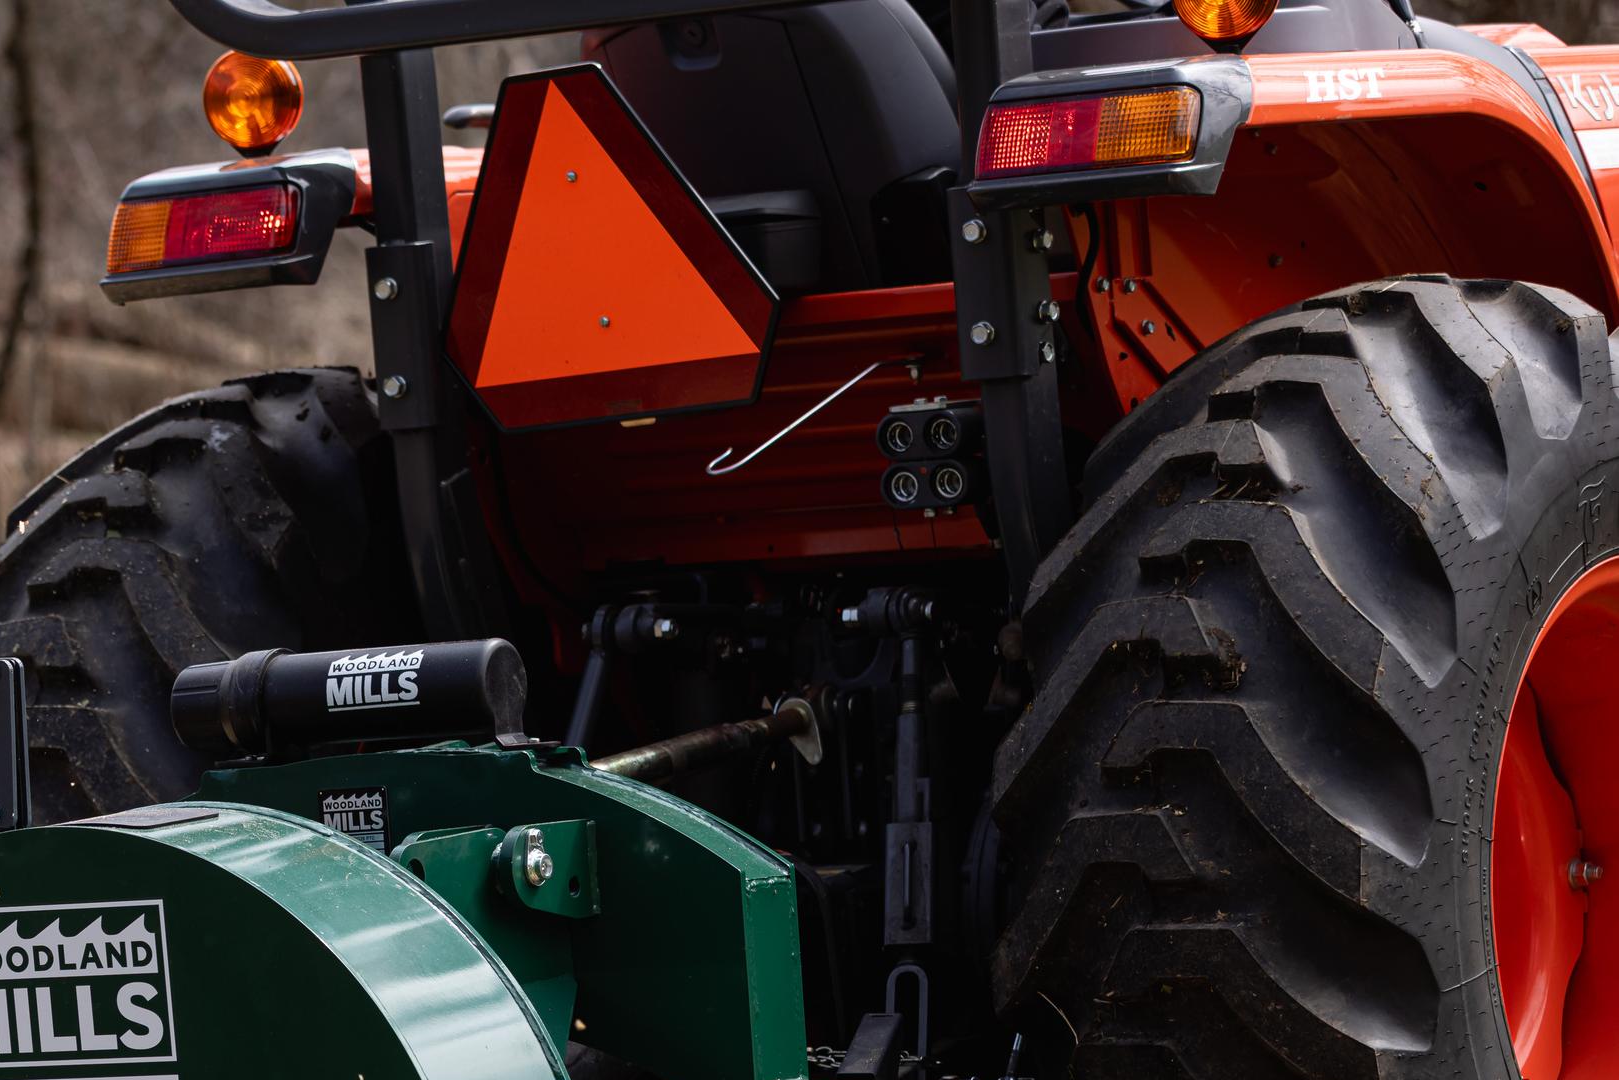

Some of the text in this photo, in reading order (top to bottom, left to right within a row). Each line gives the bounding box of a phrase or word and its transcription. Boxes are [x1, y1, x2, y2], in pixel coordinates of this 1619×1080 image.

[1303, 67, 1385, 103] HST
[332, 657, 420, 673] WOODLAND
[326, 671, 419, 707] MILLS
[324, 799, 381, 811] WOODLAND
[324, 810, 384, 832] MILLS
